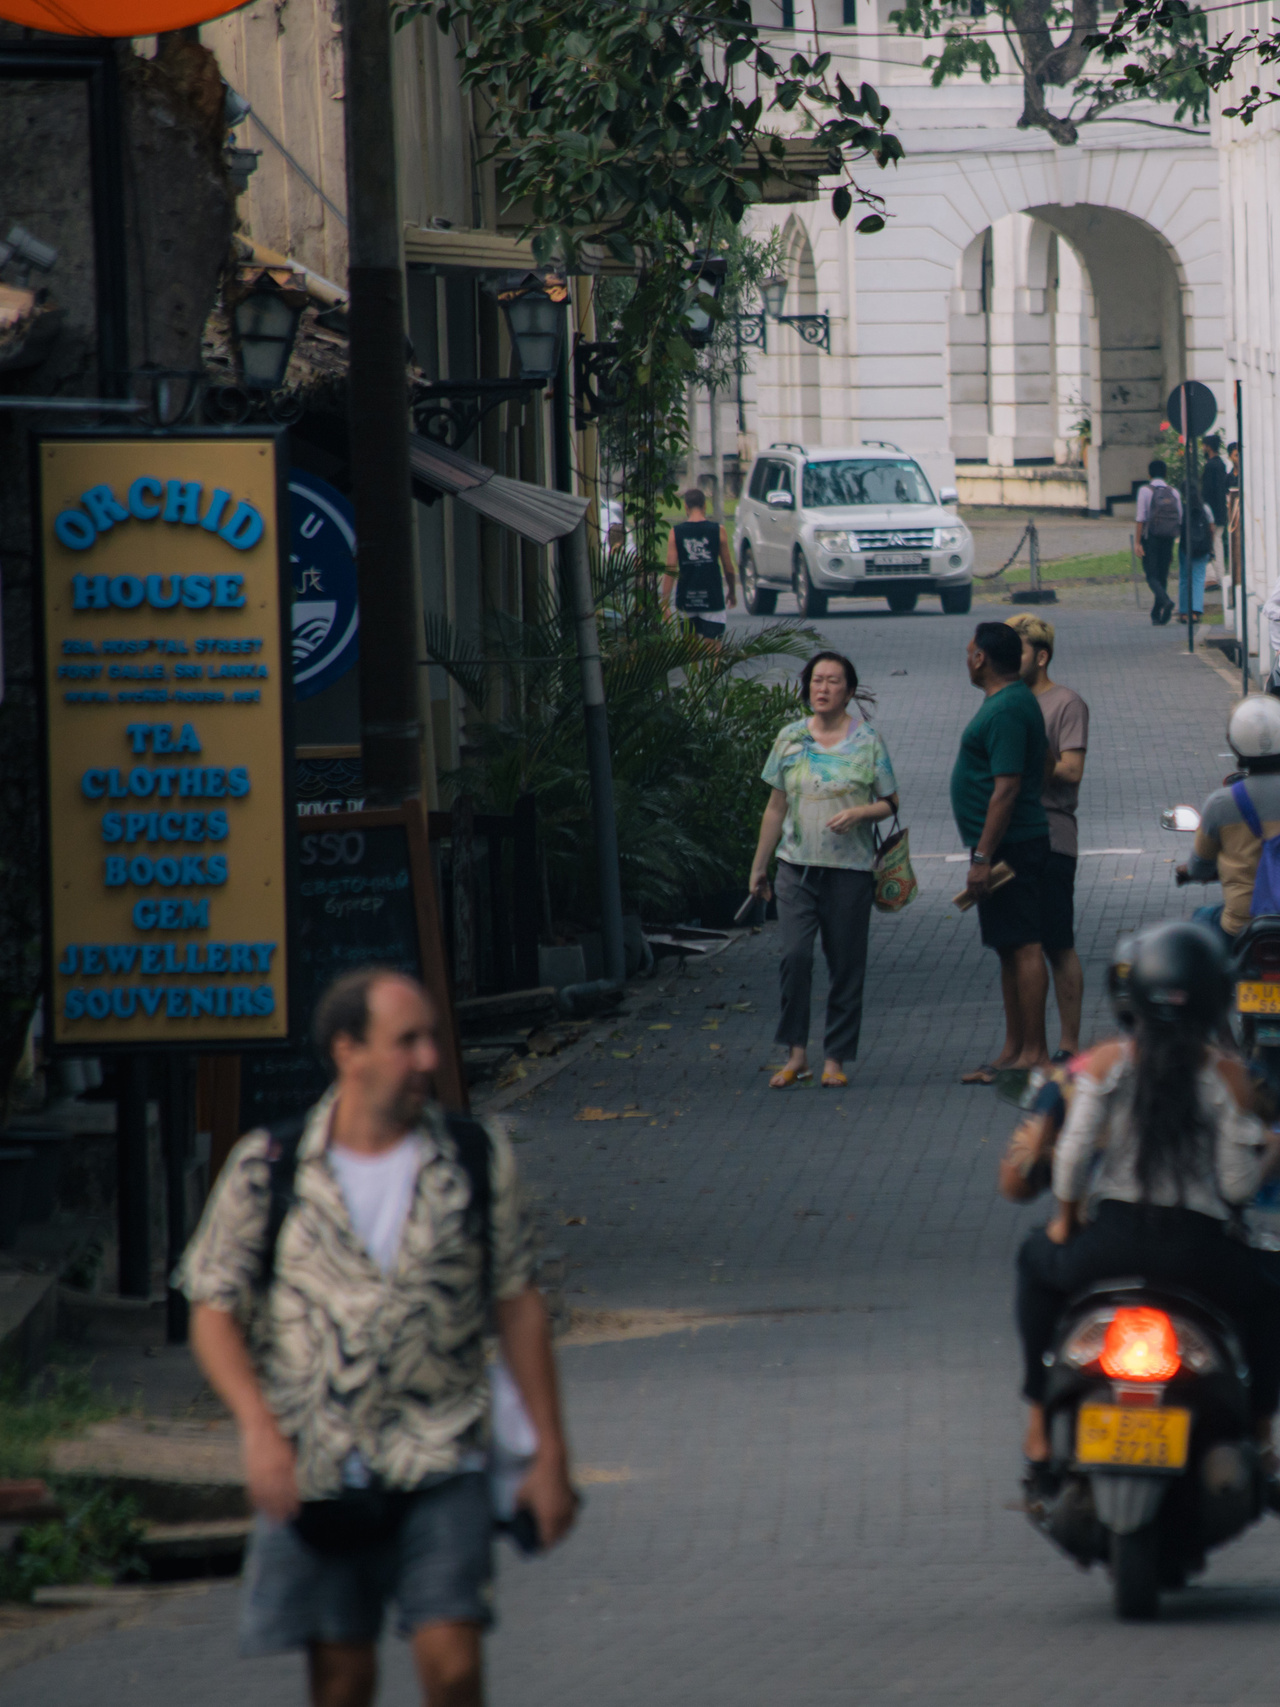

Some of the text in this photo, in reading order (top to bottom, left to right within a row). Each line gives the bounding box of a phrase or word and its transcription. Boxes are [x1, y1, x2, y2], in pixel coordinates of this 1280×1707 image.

[55, 477, 265, 551] ORCHID
[72, 574, 247, 610] HOUSE
[102, 638, 188, 655] HOSPTAL
[194, 638, 263, 655] STREET
[57, 662, 103, 680] FORT
[173, 662, 203, 680] SRI
[206, 662, 269, 680] LANKA
[126, 723, 203, 754] TEA
[81, 768, 251, 799] CLOTHES
[102, 811, 230, 843] SPICES
[105, 856, 229, 887] BOOKS
[132, 900, 210, 931] GEM
[58, 944, 277, 976] JEWELLERY
[64, 987, 276, 1020] SOUVENIRS
